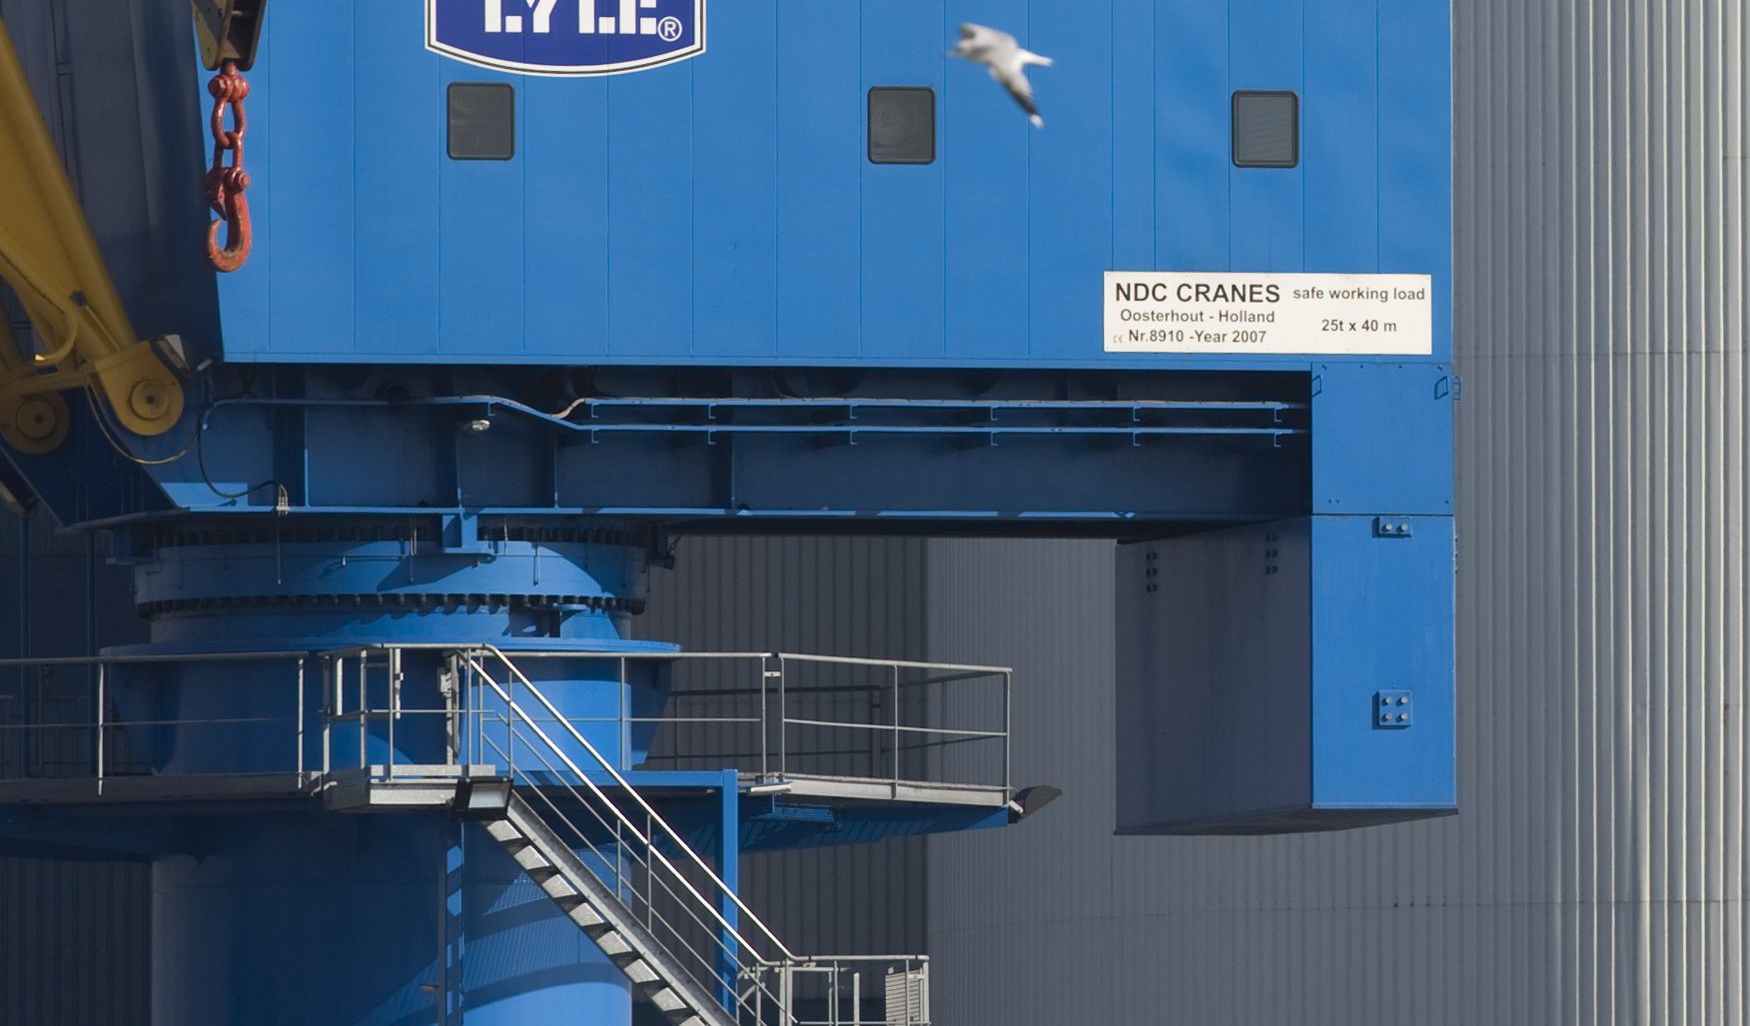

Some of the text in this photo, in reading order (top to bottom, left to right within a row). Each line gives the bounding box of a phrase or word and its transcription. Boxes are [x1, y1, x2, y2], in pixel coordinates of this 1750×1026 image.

[1116, 283, 1280, 303] NDC CRANES
[1294, 287, 1425, 303] safe working load
[1121, 309, 1204, 322] Oosterhout
[1219, 310, 1274, 323] Holland
[1322, 318, 1397, 333] 25t x 40 m
[1129, 329, 1184, 342] Nr.8910
[1232, 330, 1266, 343] 2007
